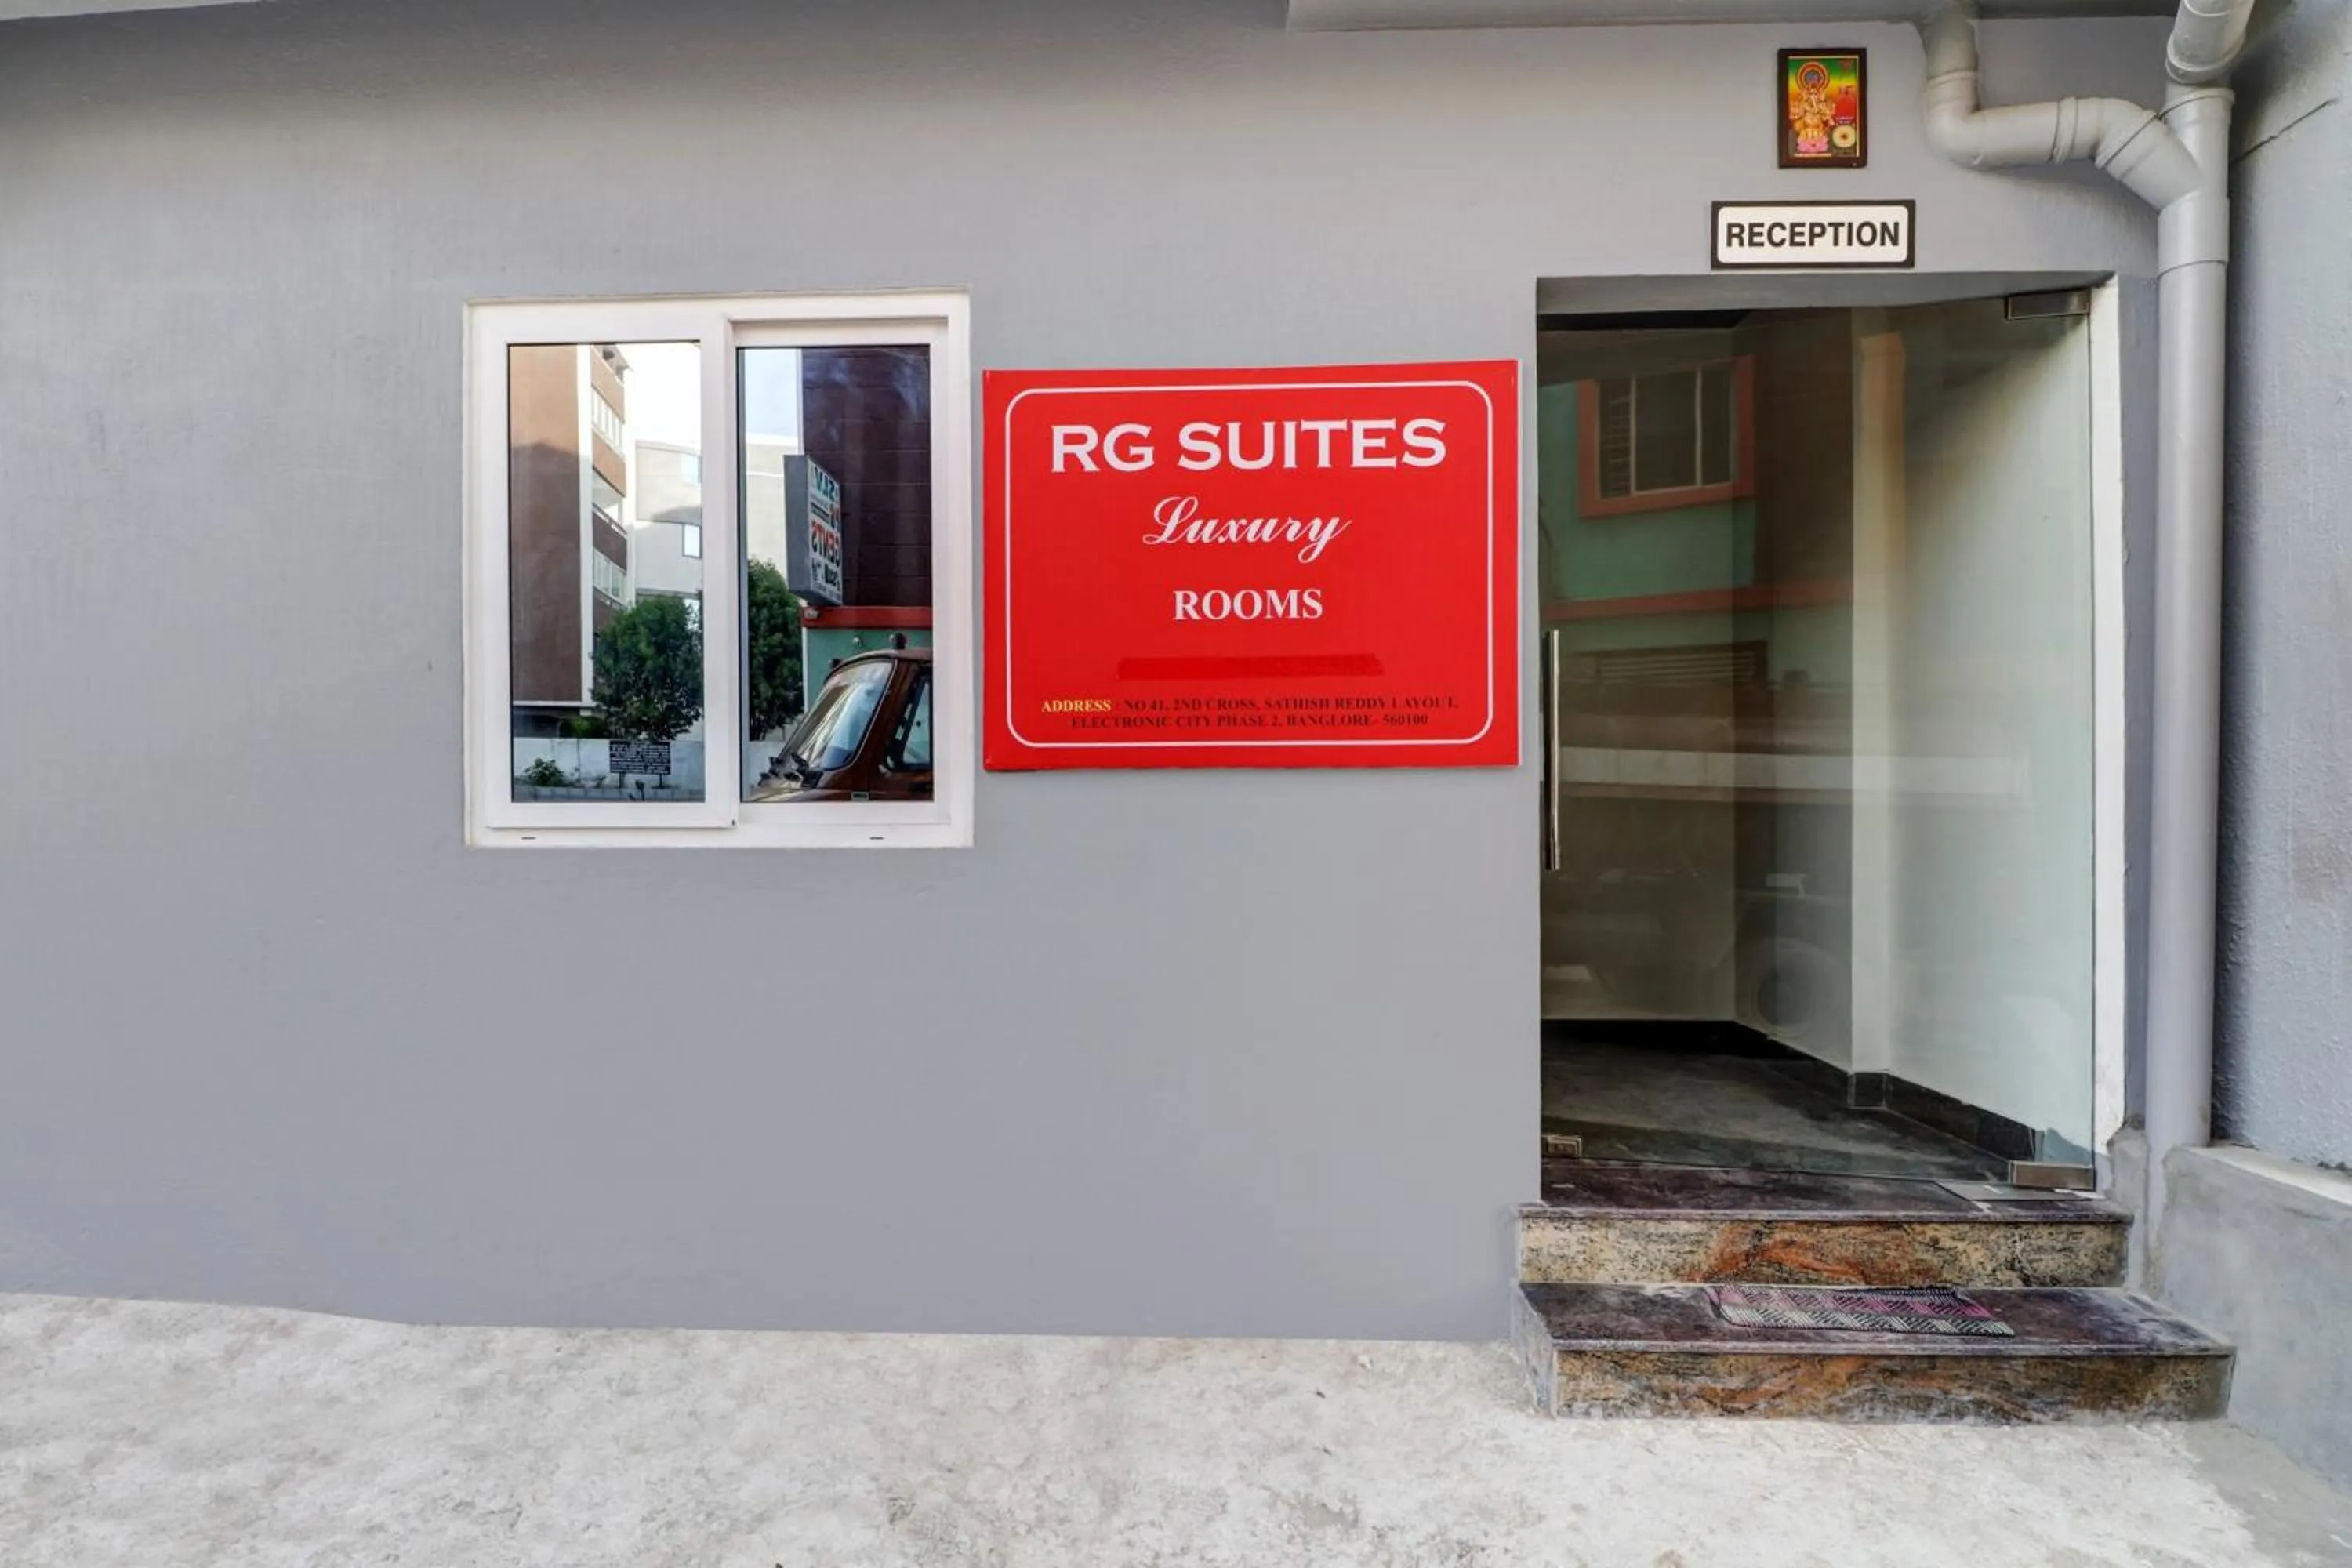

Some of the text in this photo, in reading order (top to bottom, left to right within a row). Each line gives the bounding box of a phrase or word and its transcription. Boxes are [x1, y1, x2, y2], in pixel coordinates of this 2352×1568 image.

[1726, 221, 1900, 247] RECEPTION
[1051, 418, 1446, 473] RG SUITES
[1142, 496, 1351, 564] Luxury
[1173, 589, 1323, 621] ROOMS
[1042, 699, 1112, 713] ADDRESS
[1124, 699, 1146, 712] NO
[1335, 696, 1385, 709] REDDY
[1072, 716, 1167, 728] ELECTRONIC
[1174, 715, 1211, 728] CITY
[1217, 714, 1264, 728] PHASE
[1383, 713, 1428, 726] 560100
